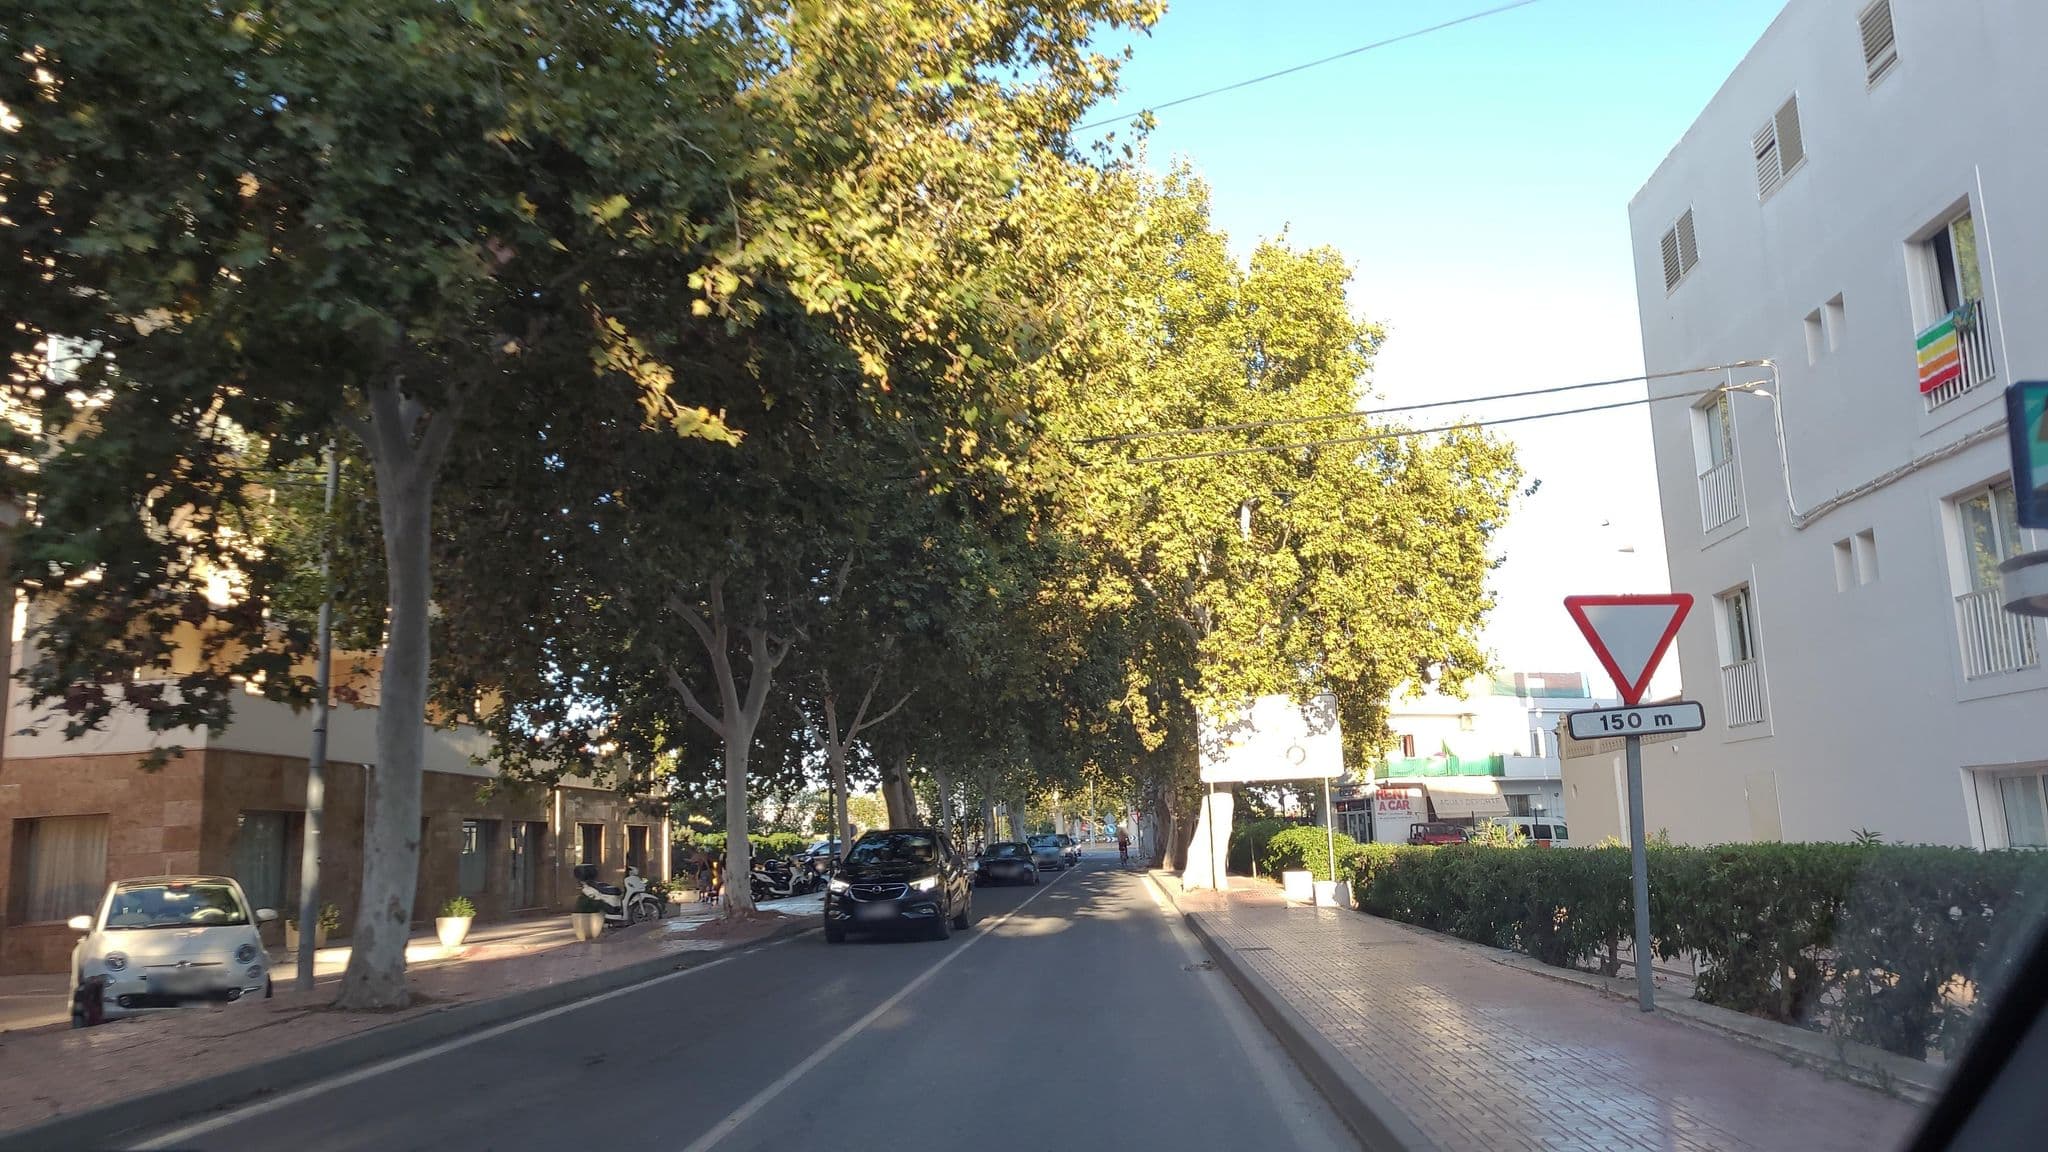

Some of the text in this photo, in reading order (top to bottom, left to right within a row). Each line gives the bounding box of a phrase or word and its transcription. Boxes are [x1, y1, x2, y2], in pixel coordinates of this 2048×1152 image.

[1600, 712, 1673, 731] 150 m
[1375, 786, 1409, 801] RENT
[1378, 800, 1410, 812] A CAR
